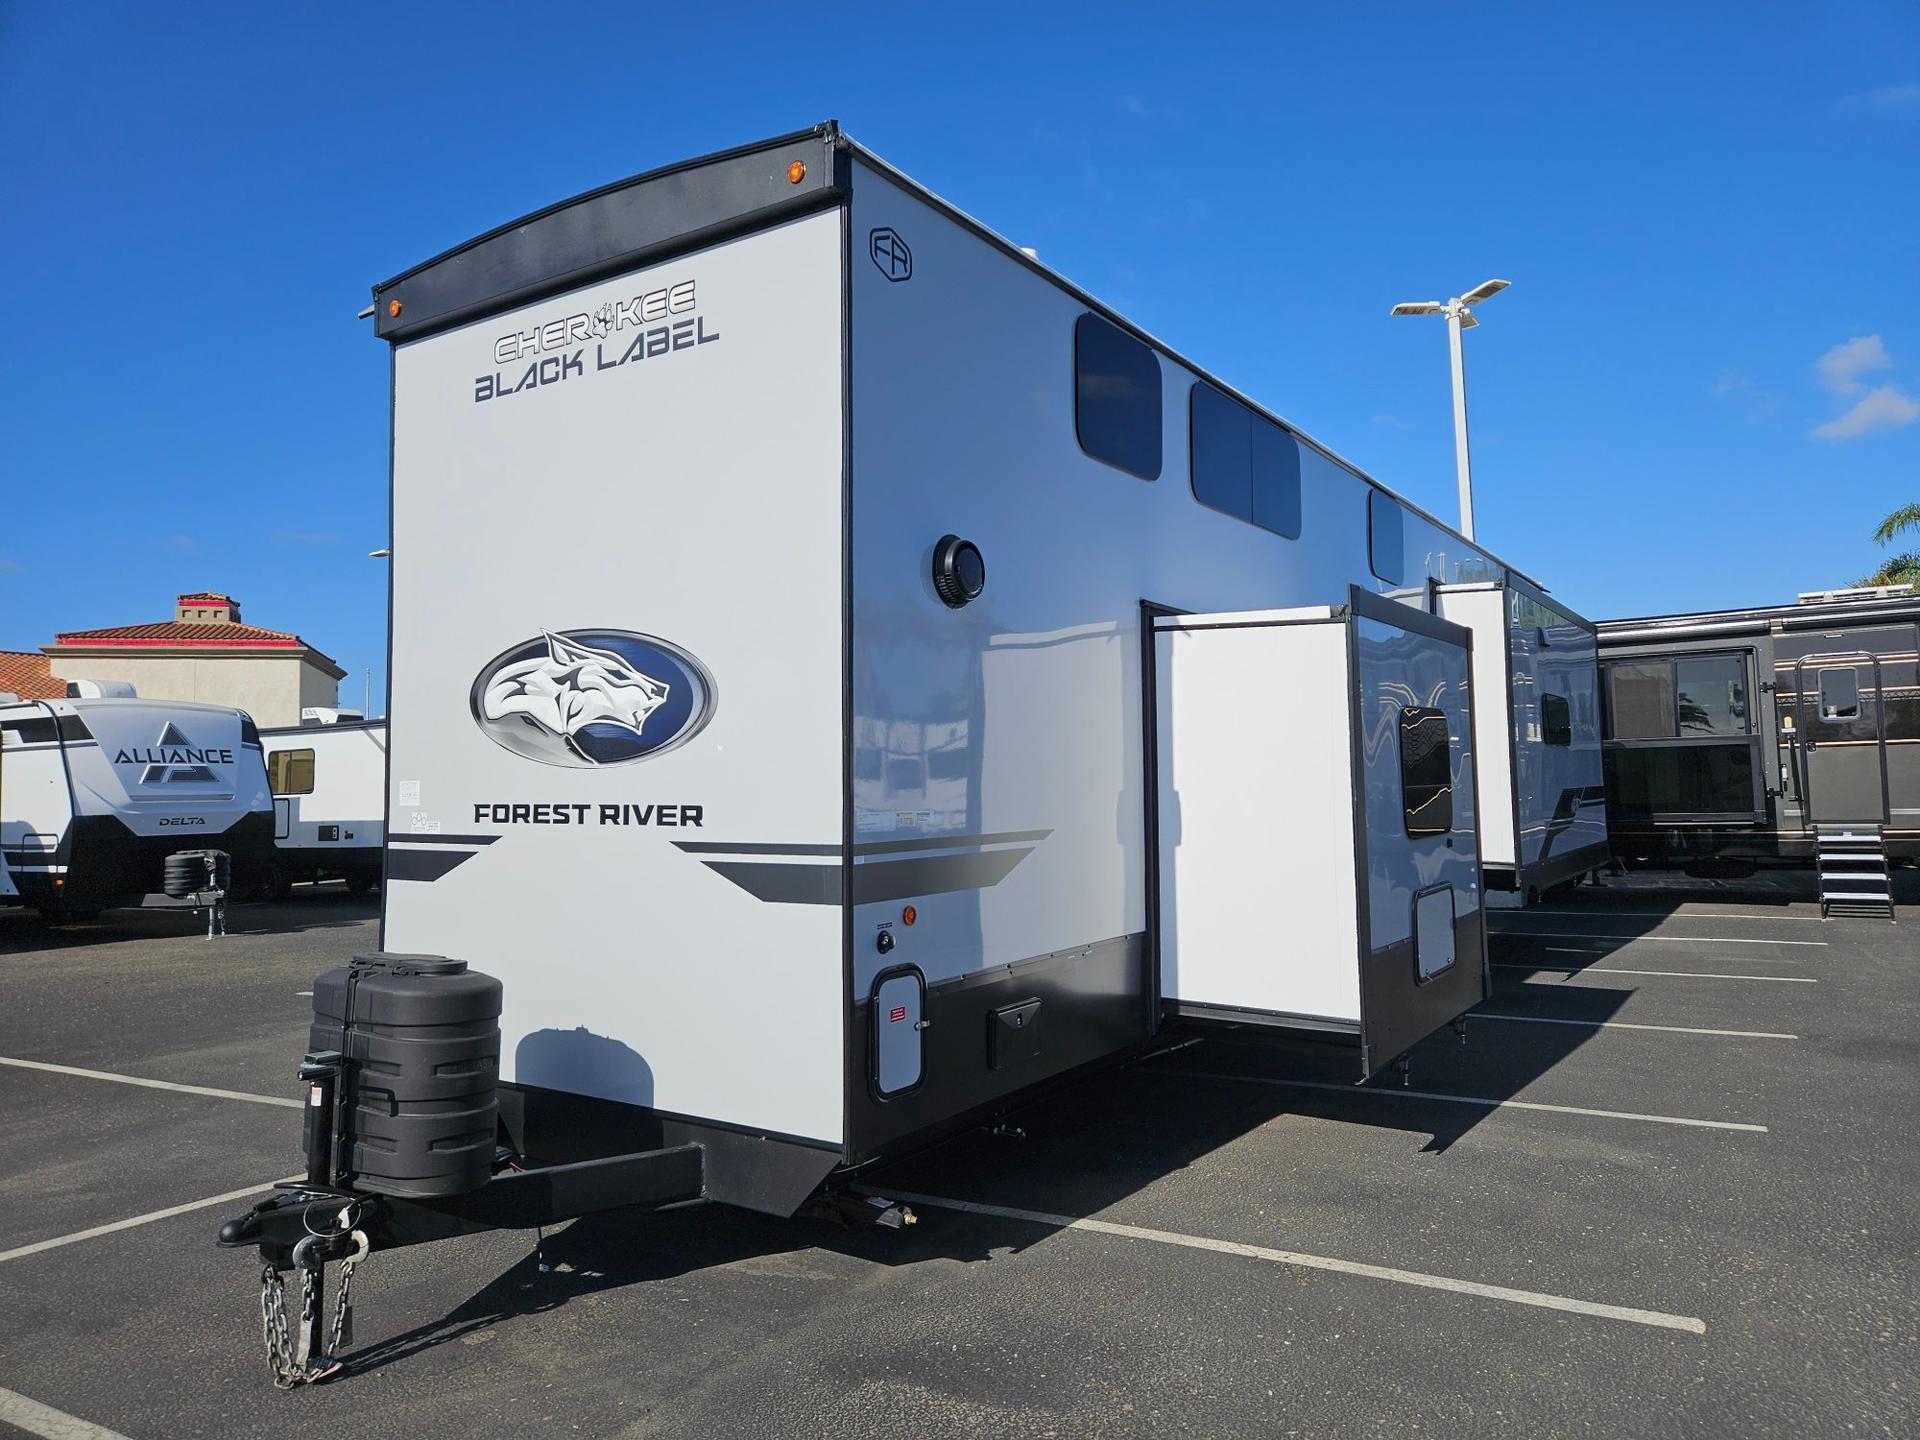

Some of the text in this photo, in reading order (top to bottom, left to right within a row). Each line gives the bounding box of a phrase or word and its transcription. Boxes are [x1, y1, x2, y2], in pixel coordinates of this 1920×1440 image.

[475, 316, 720, 402] BLACK LABEL
[115, 748, 234, 764] ALLIANCE
[159, 817, 206, 826] DELTA
[474, 803, 704, 827] FOREST RIVER
